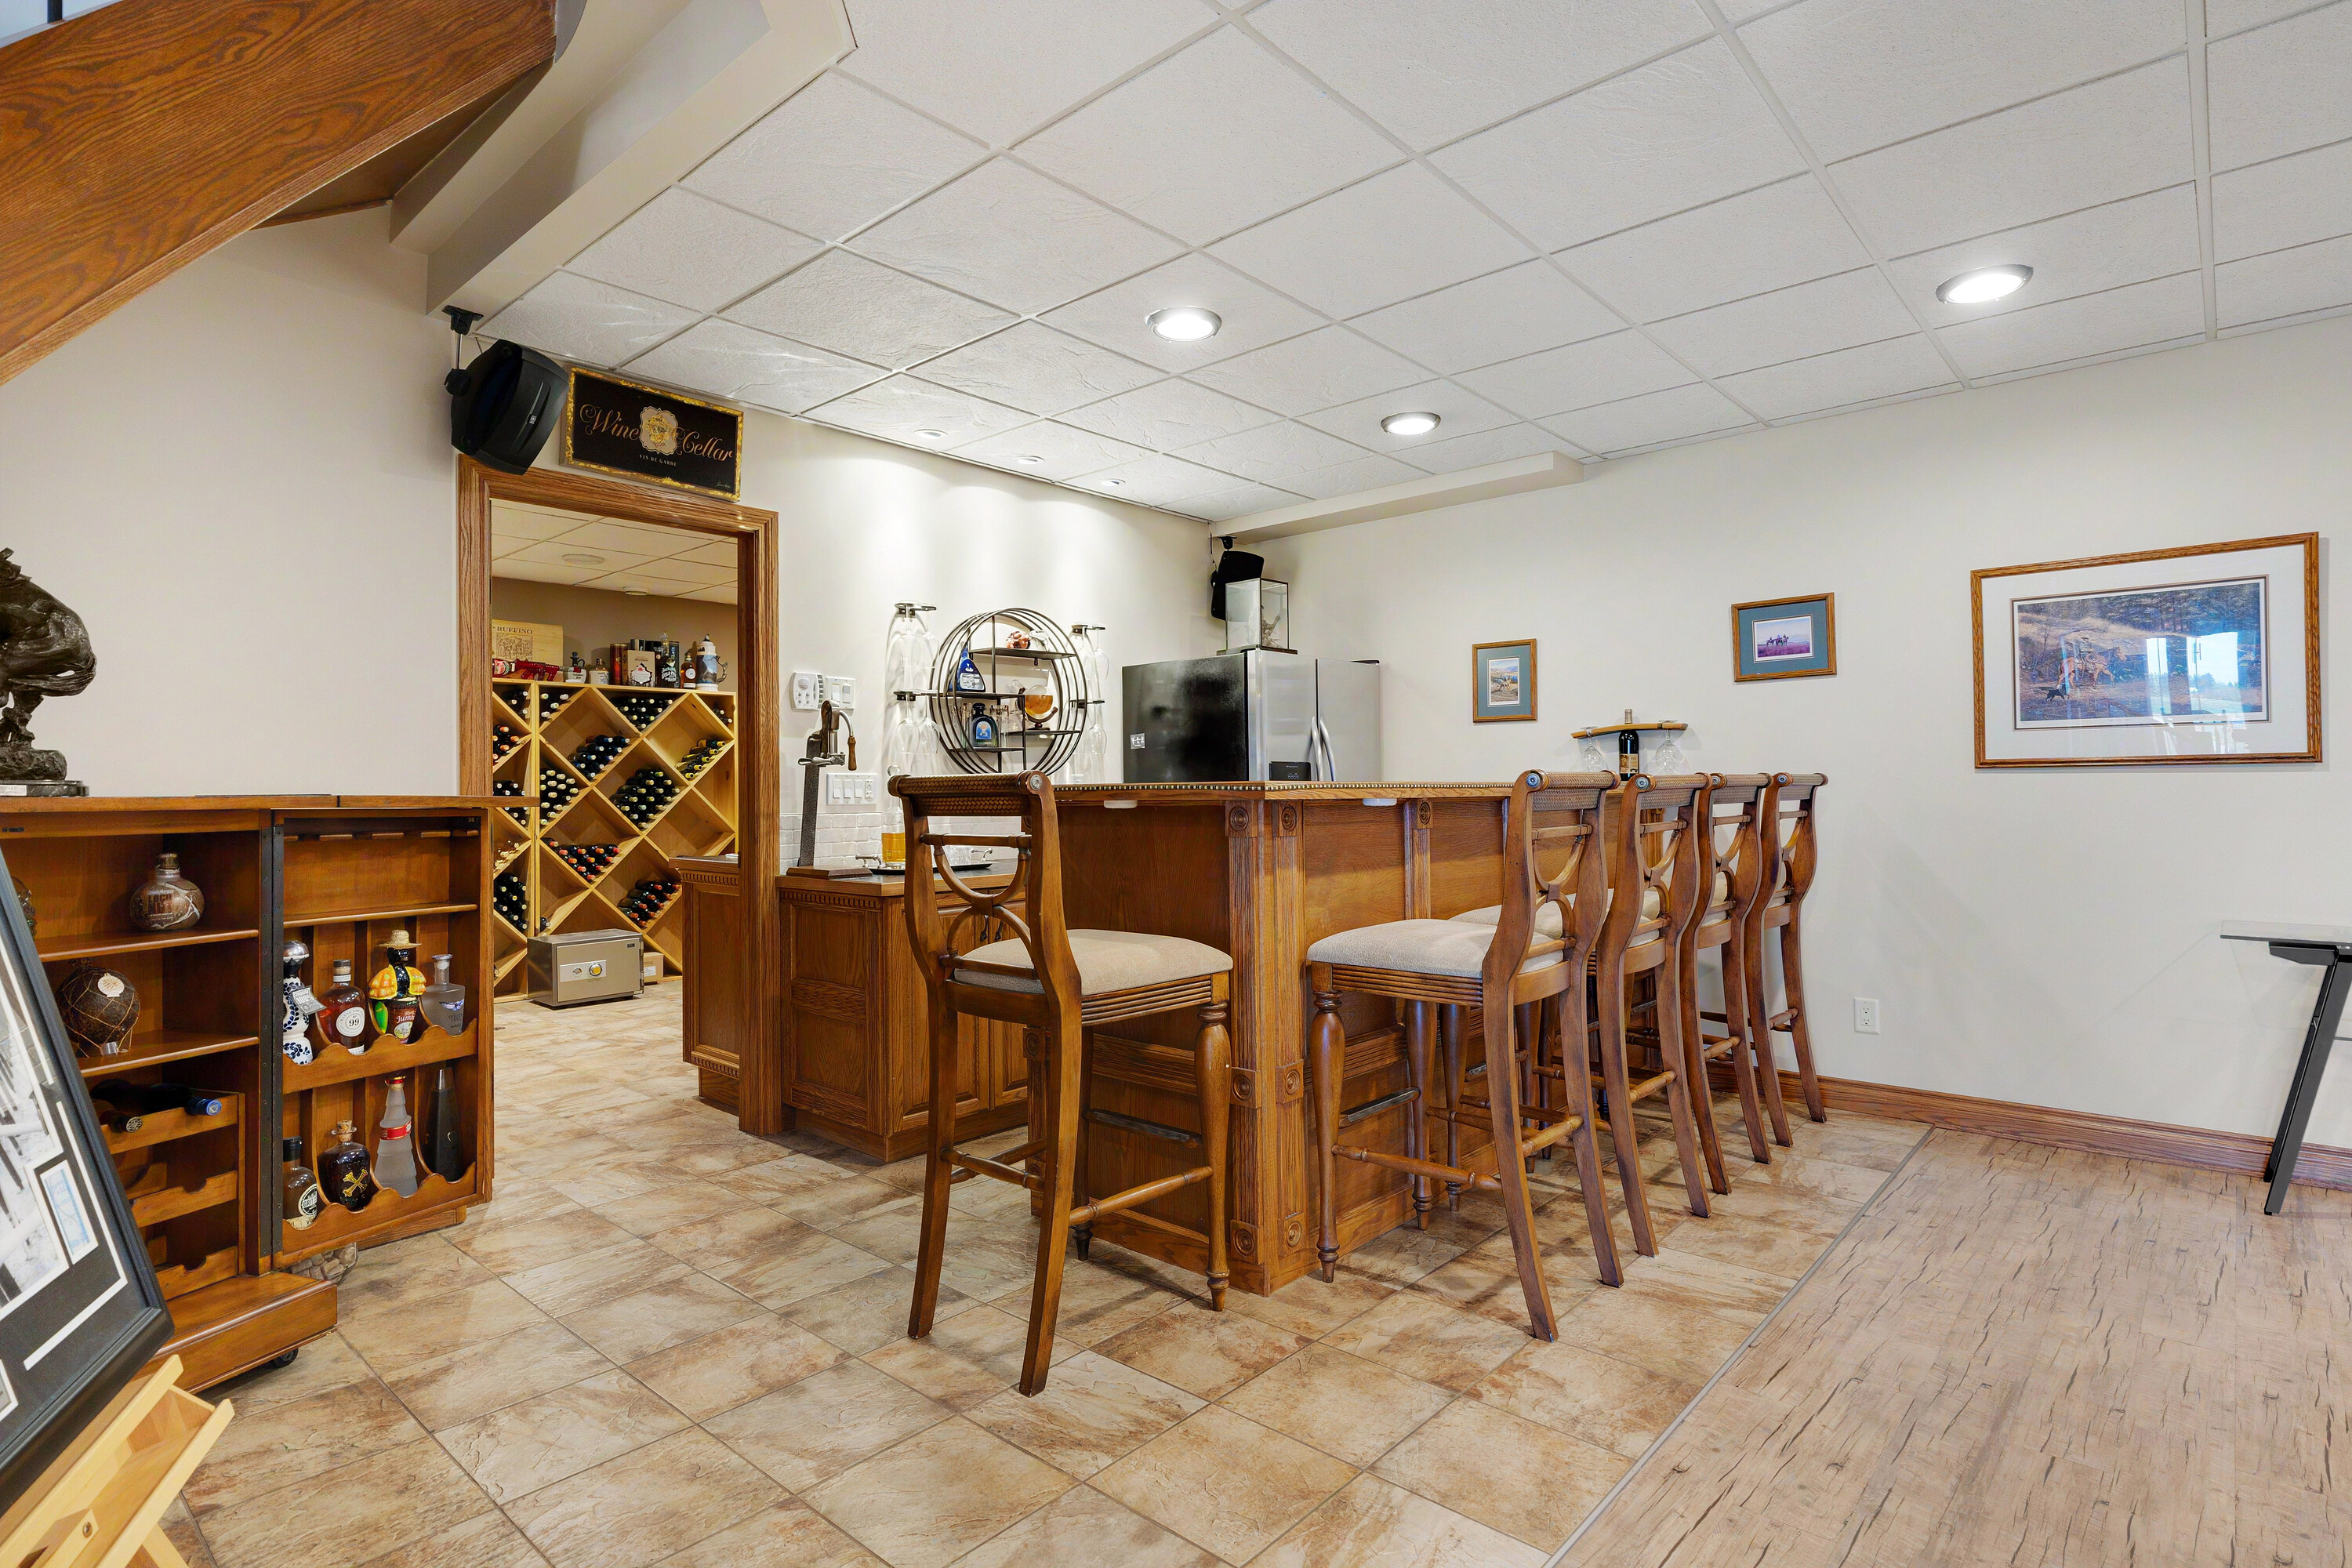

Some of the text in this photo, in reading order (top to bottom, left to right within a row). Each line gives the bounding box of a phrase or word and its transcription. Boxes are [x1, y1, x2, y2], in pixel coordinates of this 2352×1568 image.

[580, 405, 734, 461] Wine Cellar
[497, 626, 533, 634] RUFFINO
[349, 1018, 360, 1027] 99
